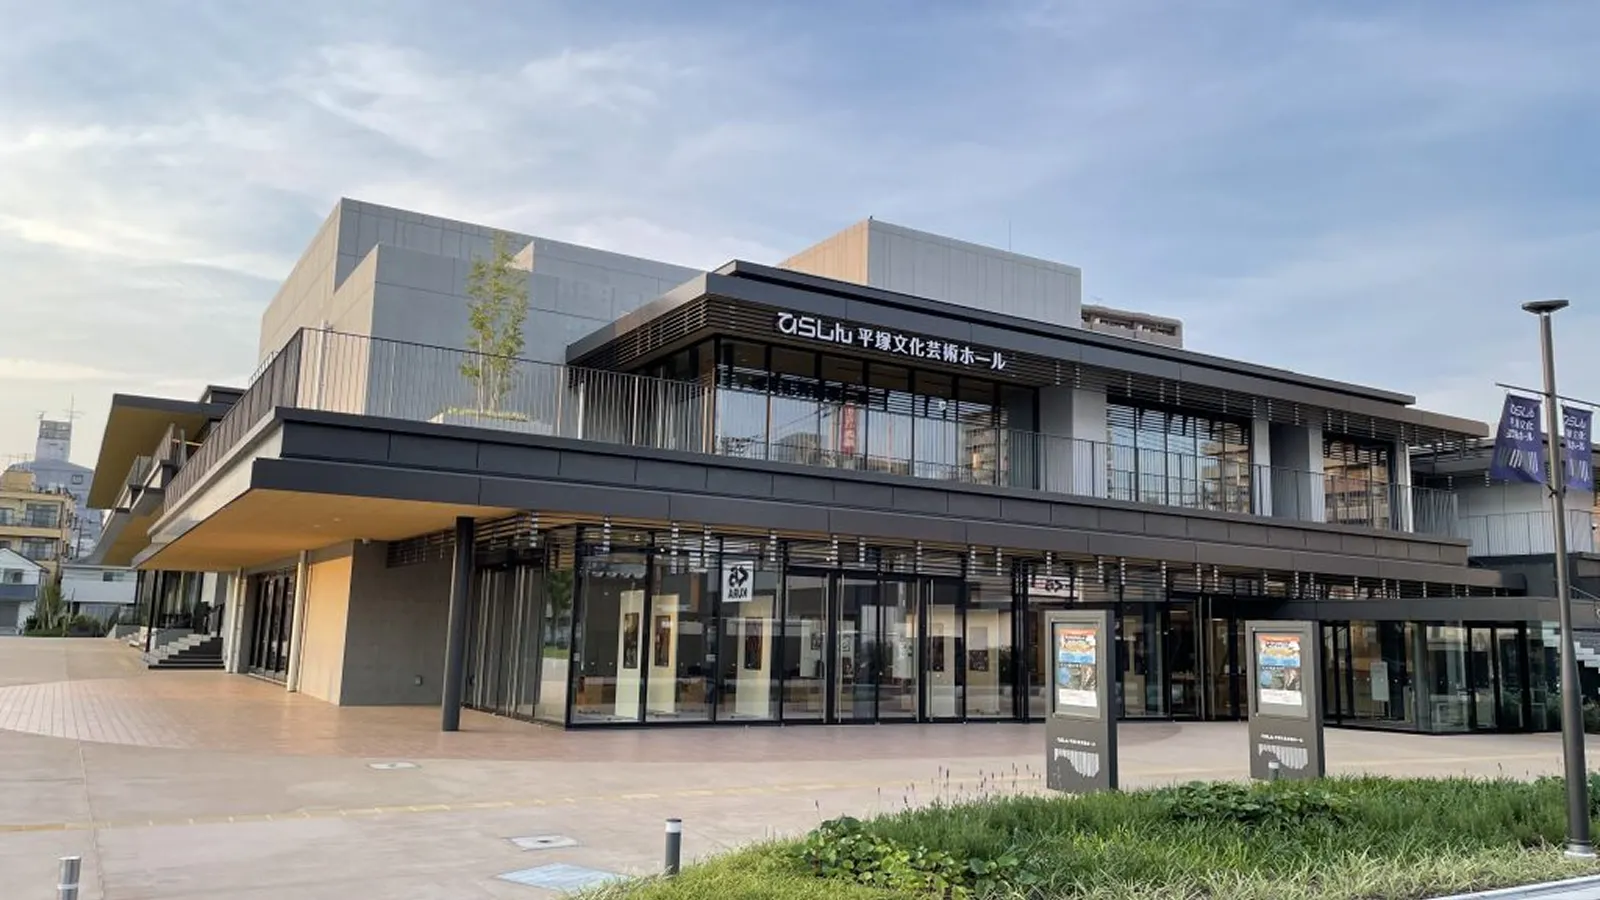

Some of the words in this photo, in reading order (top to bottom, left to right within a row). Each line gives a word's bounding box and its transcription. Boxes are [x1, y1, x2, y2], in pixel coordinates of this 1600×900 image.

[777, 312, 853, 345] ひらしん
[857, 327, 1006, 371] 平塚文化芸術ホール
